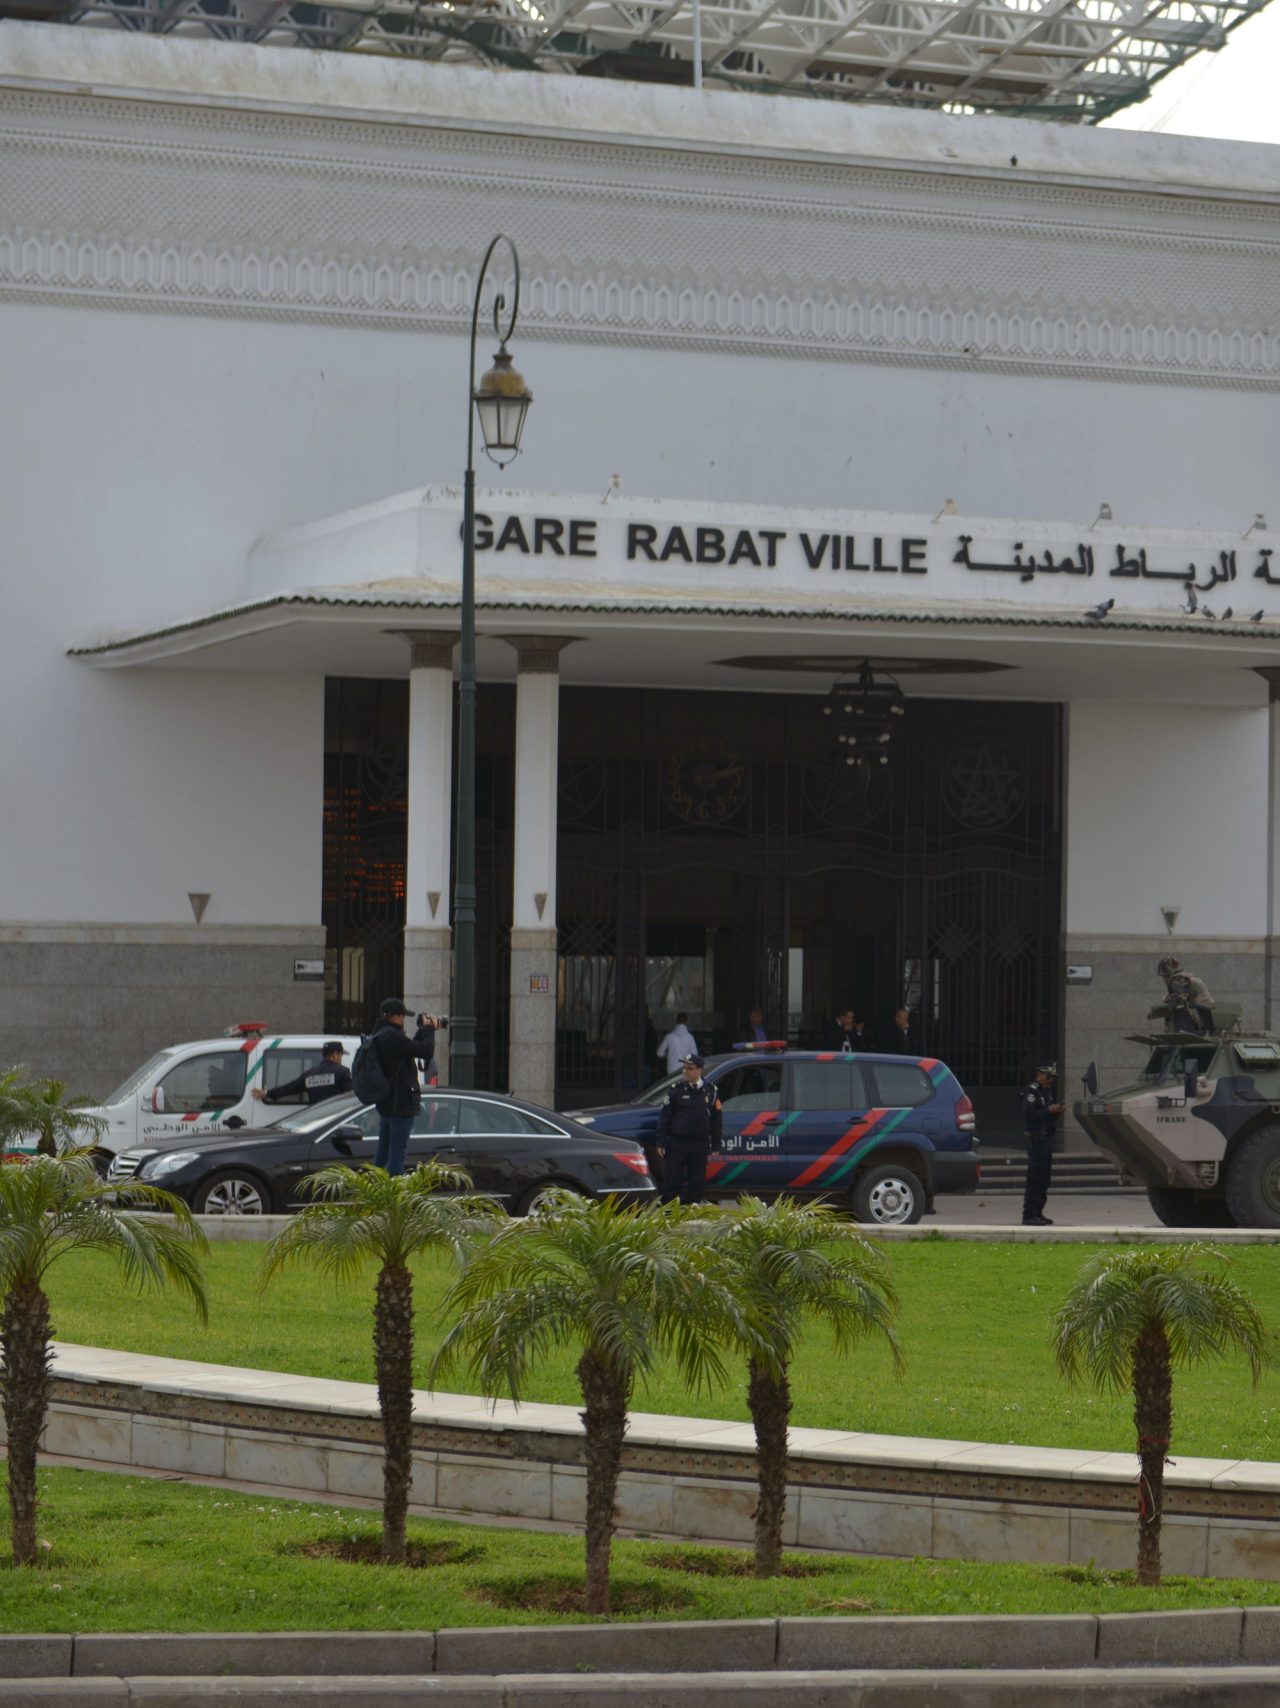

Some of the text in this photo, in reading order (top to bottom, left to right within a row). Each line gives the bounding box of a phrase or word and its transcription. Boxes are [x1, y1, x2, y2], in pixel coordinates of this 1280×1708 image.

[461, 513, 928, 573] GARE RABAT VILLE
[953, 535, 1094, 583] المدينة
[1110, 544, 1236, 591] الرباط
[726, 1154, 778, 1162] NATIONALE
